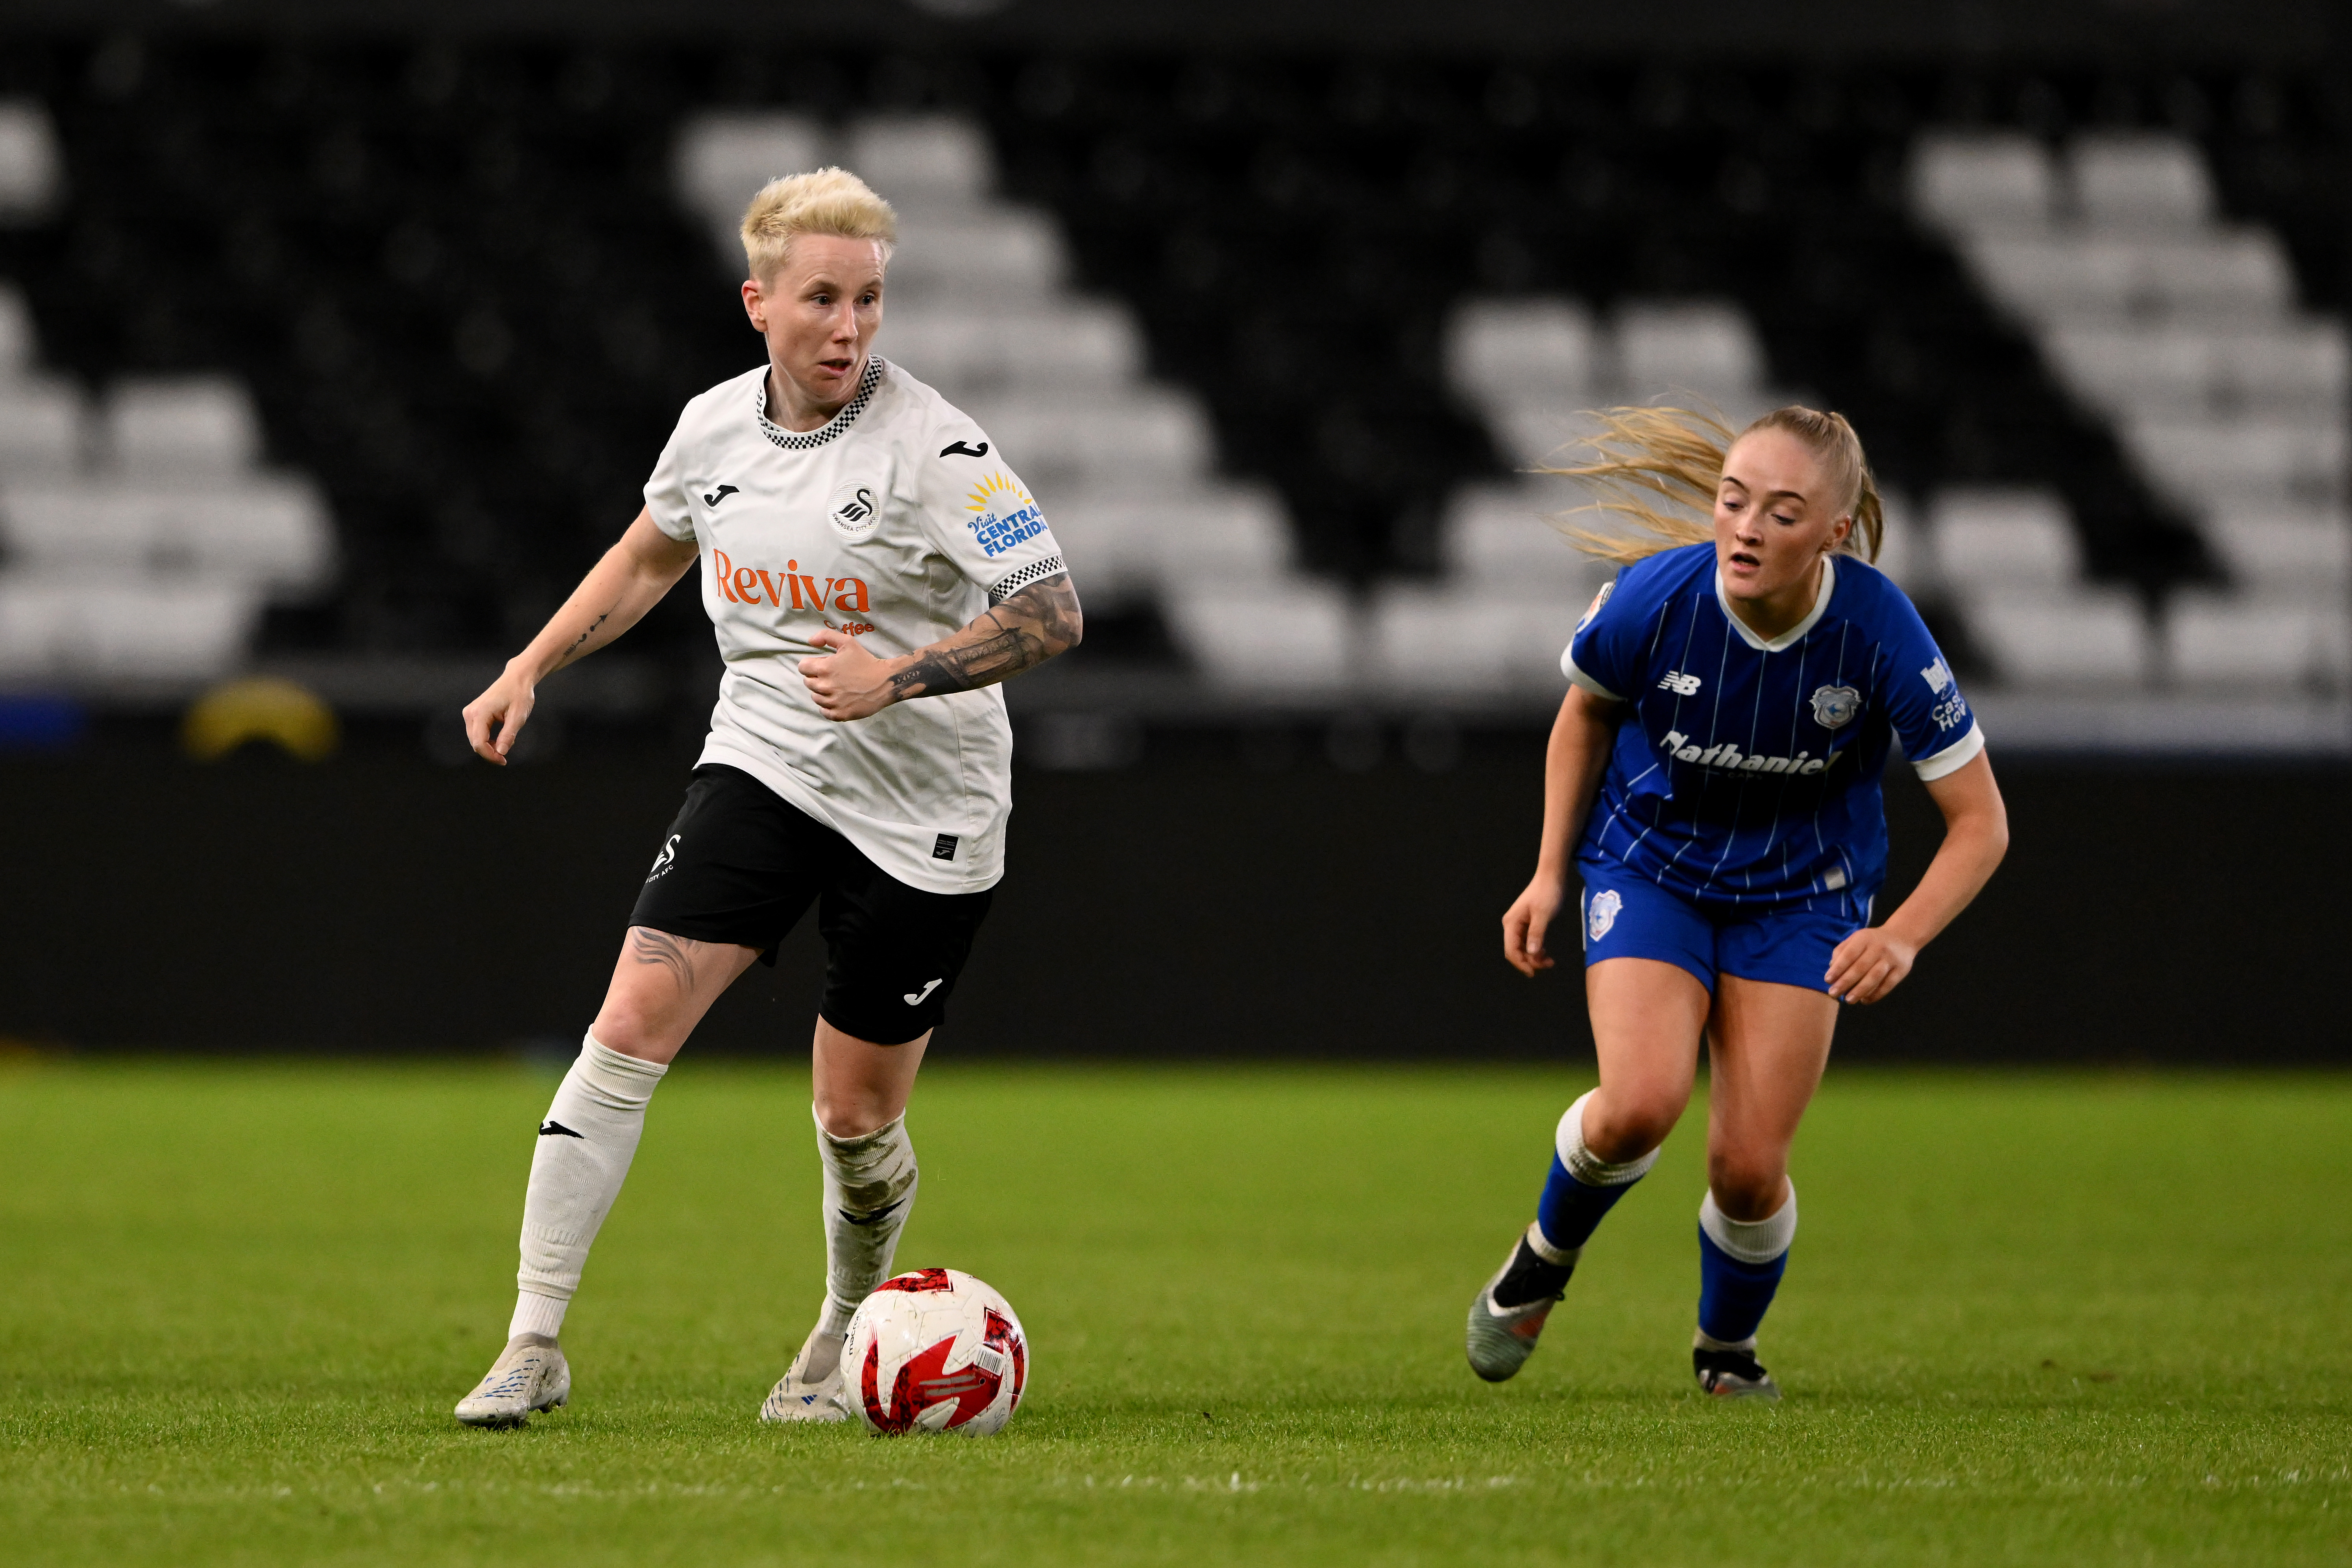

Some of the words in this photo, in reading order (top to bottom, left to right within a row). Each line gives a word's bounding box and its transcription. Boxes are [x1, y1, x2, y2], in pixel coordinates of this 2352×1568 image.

[833, 513, 853, 531] SWANSEA
[967, 513, 997, 534] Visit
[977, 503, 1042, 545] CENTRAL
[983, 518, 1048, 557] FLORIDA
[713, 548, 870, 613] Reviva
[824, 620, 875, 636] Cffee
[1659, 730, 1843, 775] Nathaniel
[649, 873, 660, 883] CITY
[661, 864, 673, 876] AFC
[849, 1312, 861, 1356] macron
